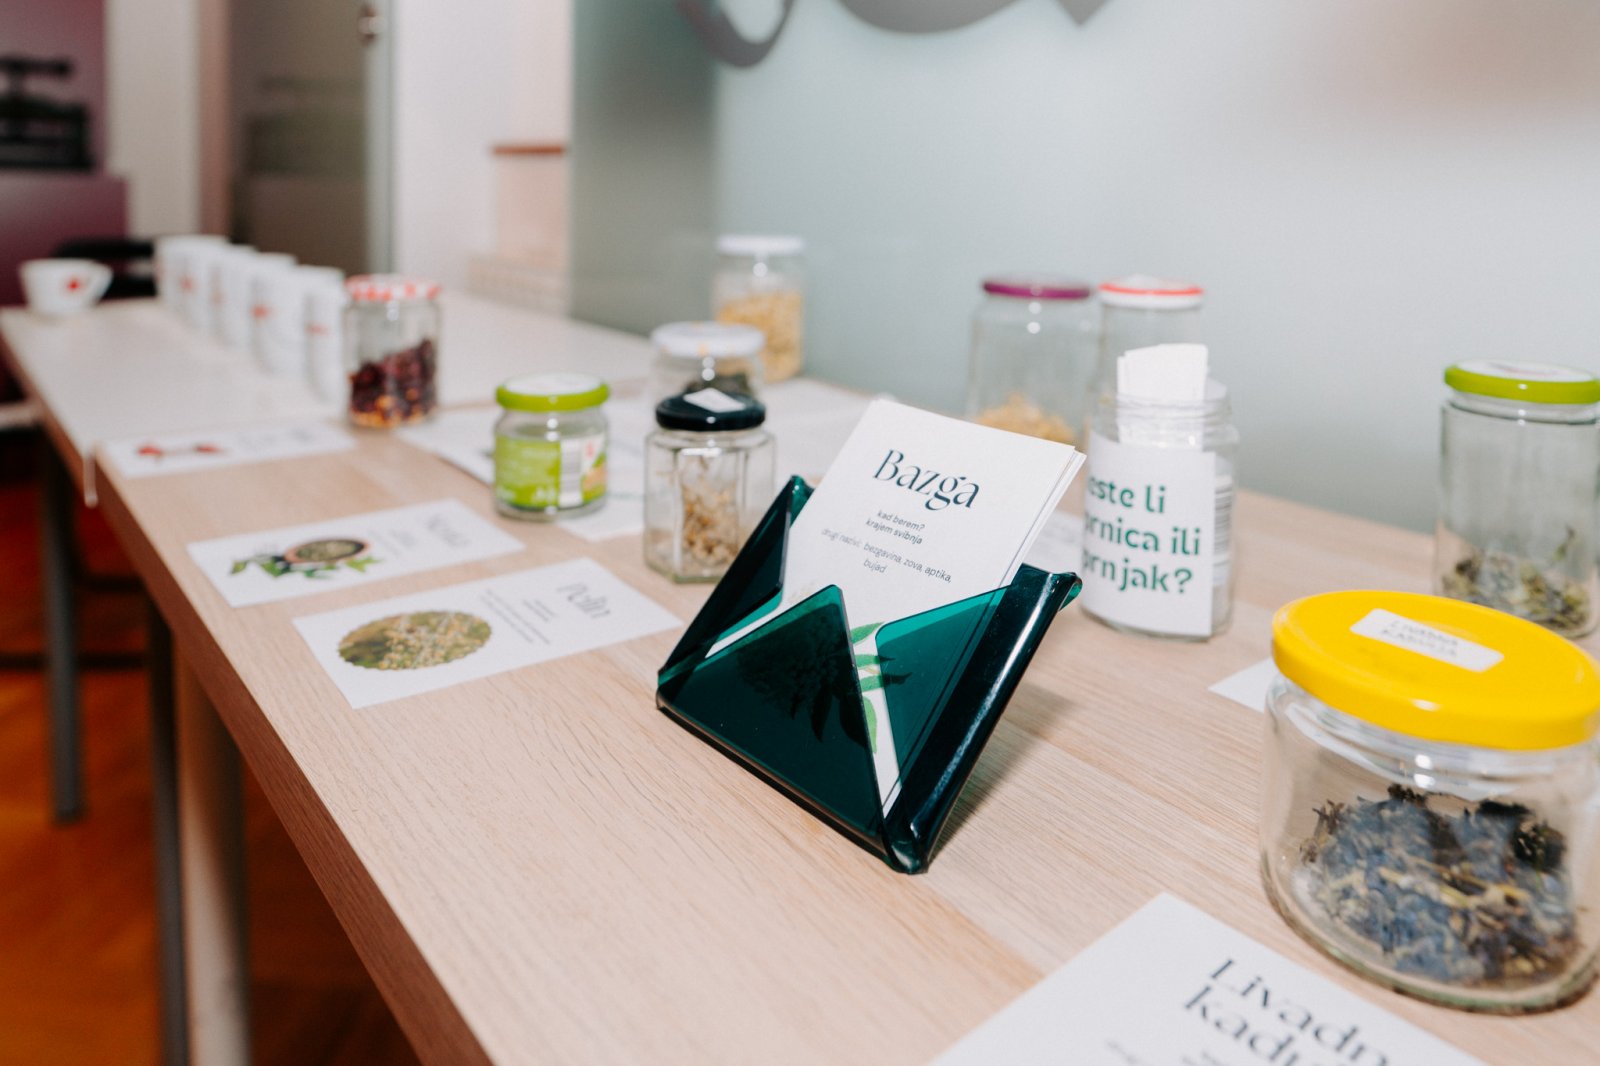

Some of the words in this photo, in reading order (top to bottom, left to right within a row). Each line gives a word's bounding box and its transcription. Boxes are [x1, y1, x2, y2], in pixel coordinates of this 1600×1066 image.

[873, 449, 979, 511] Bazga
[1145, 485, 1166, 513] li
[866, 518, 892, 534] krajem
[893, 529, 923, 545] svibnja
[877, 510, 893, 521] kad
[893, 513, 925, 531] berem?
[1171, 526, 1201, 555] ili
[863, 558, 887, 574] bujad
[903, 558, 923, 573] zova,
[925, 567, 952, 583] aptika,
